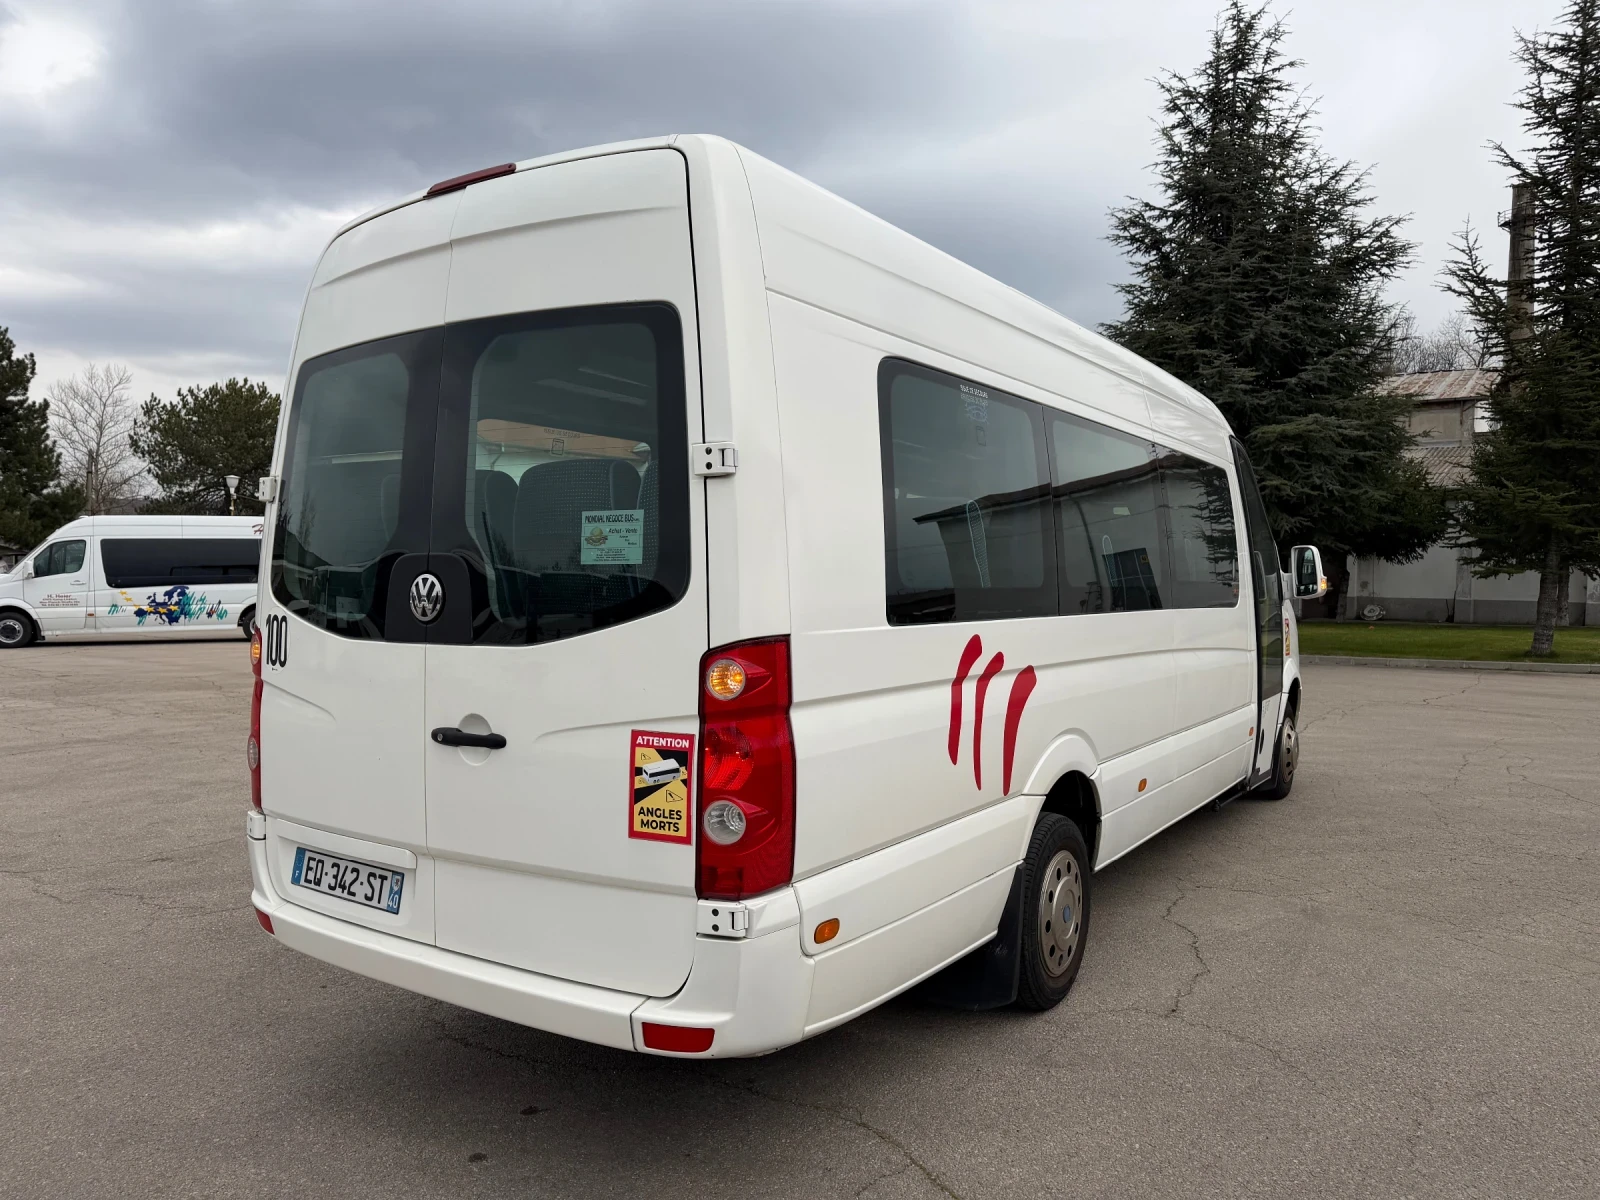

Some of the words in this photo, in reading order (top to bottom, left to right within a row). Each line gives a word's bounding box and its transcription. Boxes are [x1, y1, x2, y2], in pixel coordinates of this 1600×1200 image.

[585, 514, 605, 524] MONDIAL
[605, 514, 624, 523] NEGOCE
[625, 513, 634, 522] BUS
[266, 613, 288, 667] 100
[636, 736, 690, 748] ATTENTION
[638, 806, 682, 820] ANGLES
[640, 819, 680, 832] MORTS
[294, 870, 300, 878] F
[387, 894, 399, 909] 40
